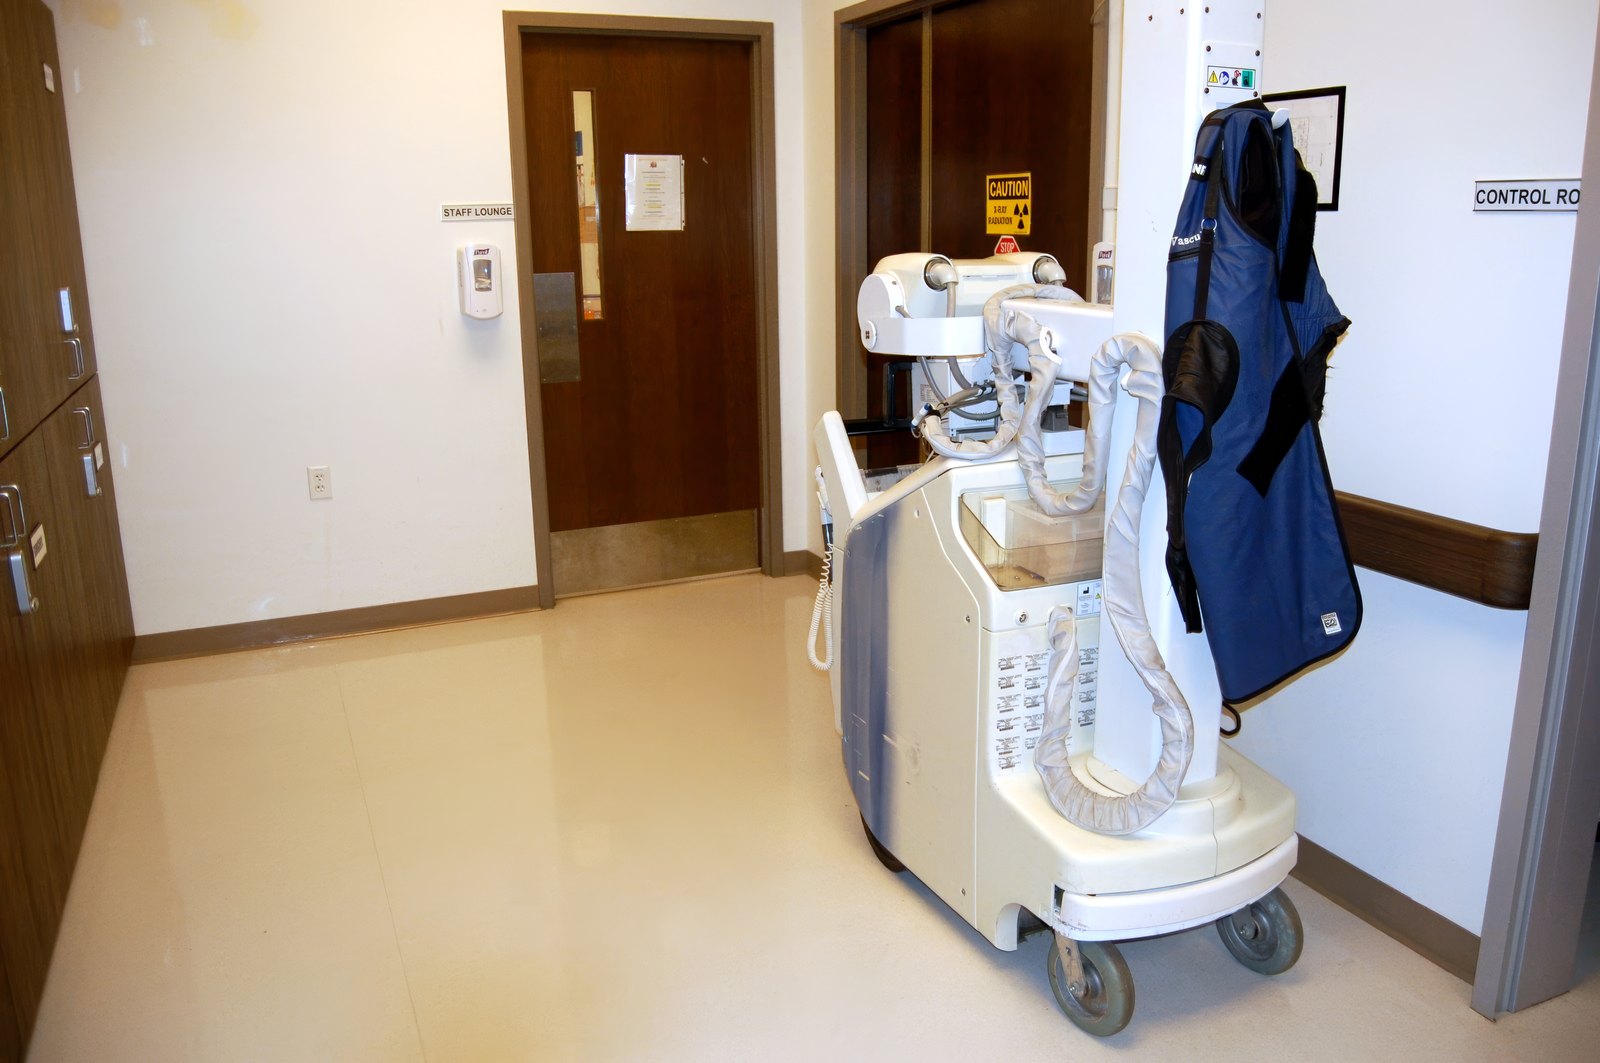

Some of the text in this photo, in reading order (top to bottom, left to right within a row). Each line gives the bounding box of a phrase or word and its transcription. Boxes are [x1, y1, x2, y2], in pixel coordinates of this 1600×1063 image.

[990, 180, 1028, 197] CAUTION
[1476, 189, 1580, 204] CONTROL RO
[444, 207, 512, 217] STAFF LOUNGE
[993, 205, 1007, 214] X-RAY
[988, 216, 1012, 225] RADIATION
[1171, 231, 1202, 246] Vascu
[1000, 242, 1015, 253] STOP
